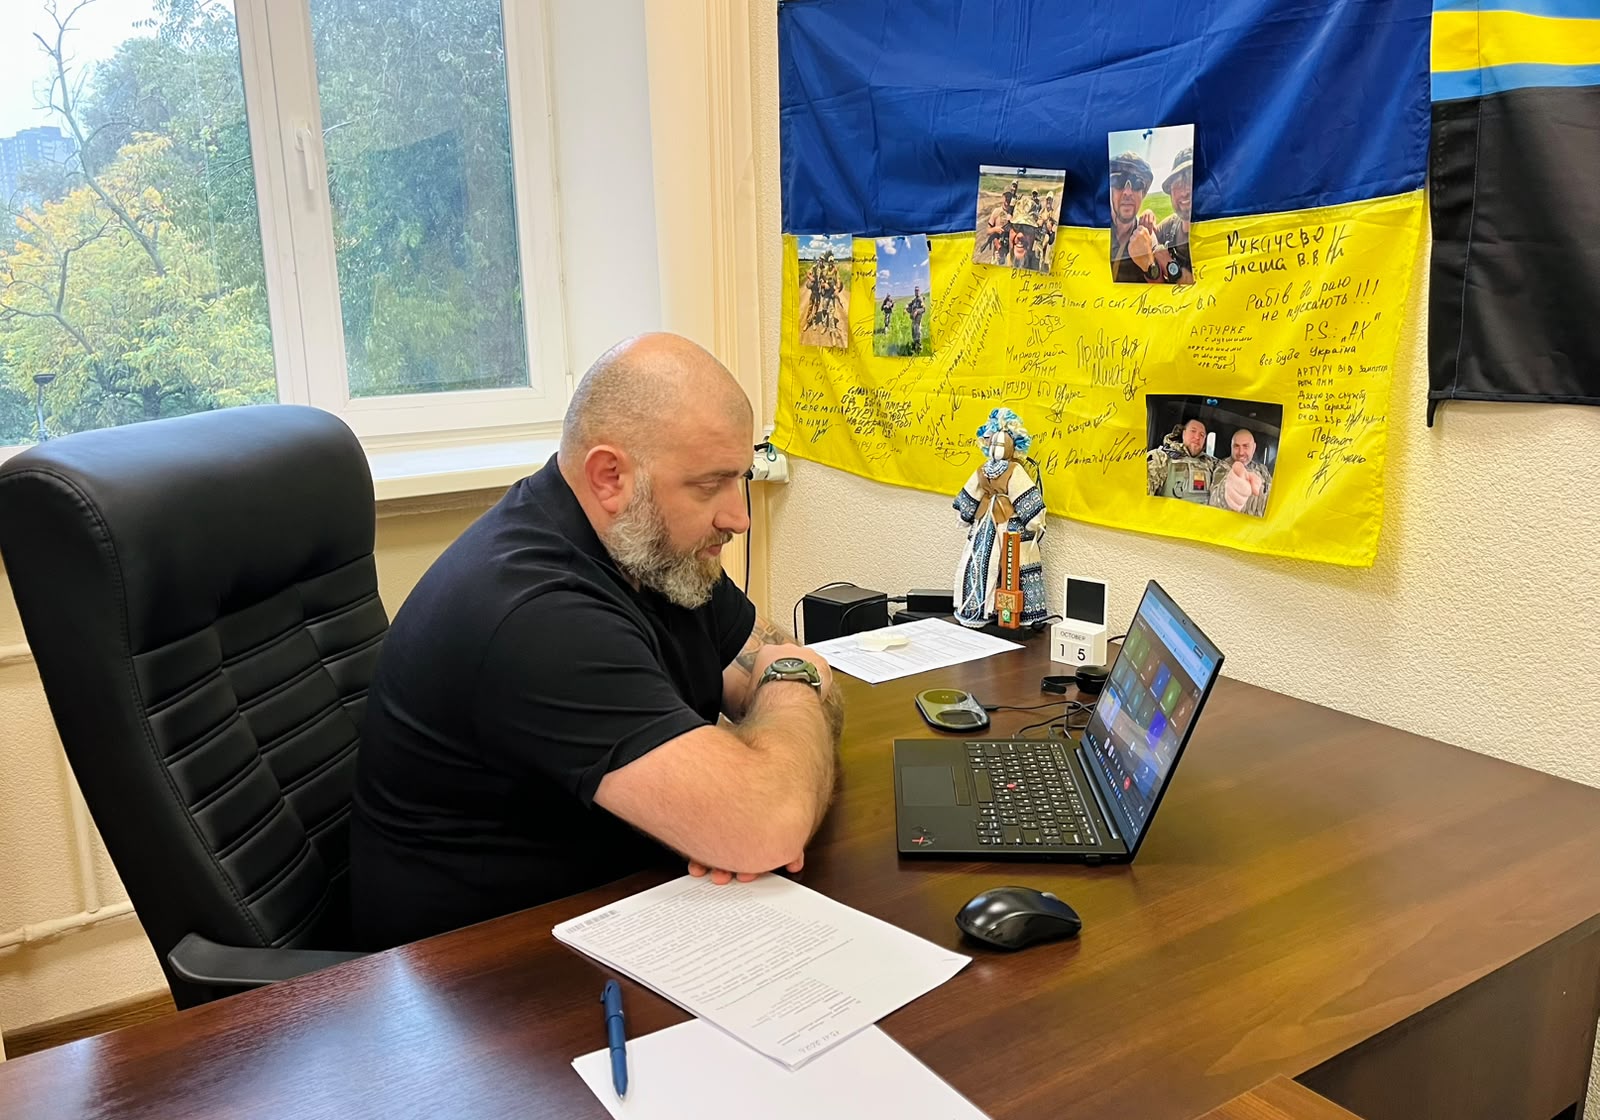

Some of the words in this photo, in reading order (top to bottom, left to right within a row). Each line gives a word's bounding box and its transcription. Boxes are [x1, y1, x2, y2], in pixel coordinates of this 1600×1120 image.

[1321, 276, 1351, 301] раю
[1060, 630, 1087, 641] OCTOBER
[1059, 643, 1065, 657] 1
[1077, 648, 1086, 661] 5
